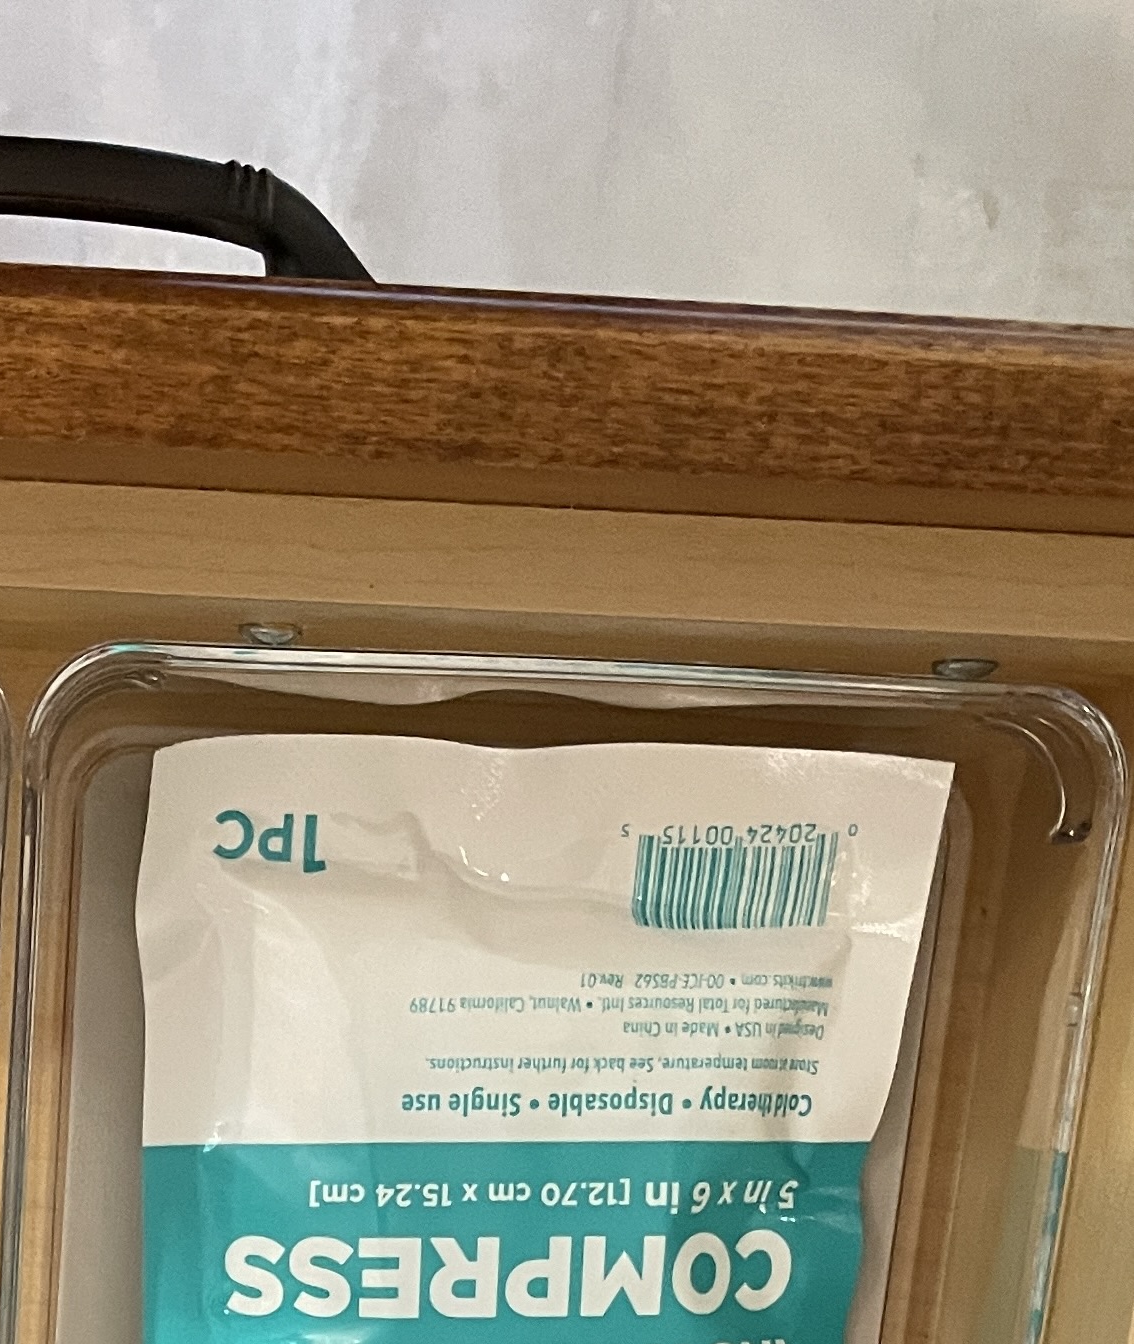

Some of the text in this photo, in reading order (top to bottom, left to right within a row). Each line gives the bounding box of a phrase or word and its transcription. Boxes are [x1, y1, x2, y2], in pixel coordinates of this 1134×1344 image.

[213, 810, 327, 875] 1PC
[620, 823, 859, 849] 0 20424 00115 5
[409, 997, 456, 1014] 91789
[460, 996, 525, 1014] California
[628, 997, 695, 1014] Resources
[698, 998, 730, 1015] Total
[732, 998, 750, 1015] for
[623, 1021, 661, 1038] China
[665, 1022, 678, 1038] in
[681, 1022, 719, 1038] Made
[735, 1022, 762, 1038] USA
[766, 1023, 777, 1039] in
[425, 1056, 514, 1074] instructions.
[518, 1057, 567, 1074] further
[571, 1057, 590, 1074] for
[592, 1057, 625, 1074] back
[629, 1057, 654, 1073] See
[401, 1085, 812, 1118] Cold therapy Disposable Single use
[309, 1178, 799, 1214] 5 in x 6 in [12.70 cm x 15.24 cm]
[224, 1229, 793, 1319] COMPRESS
